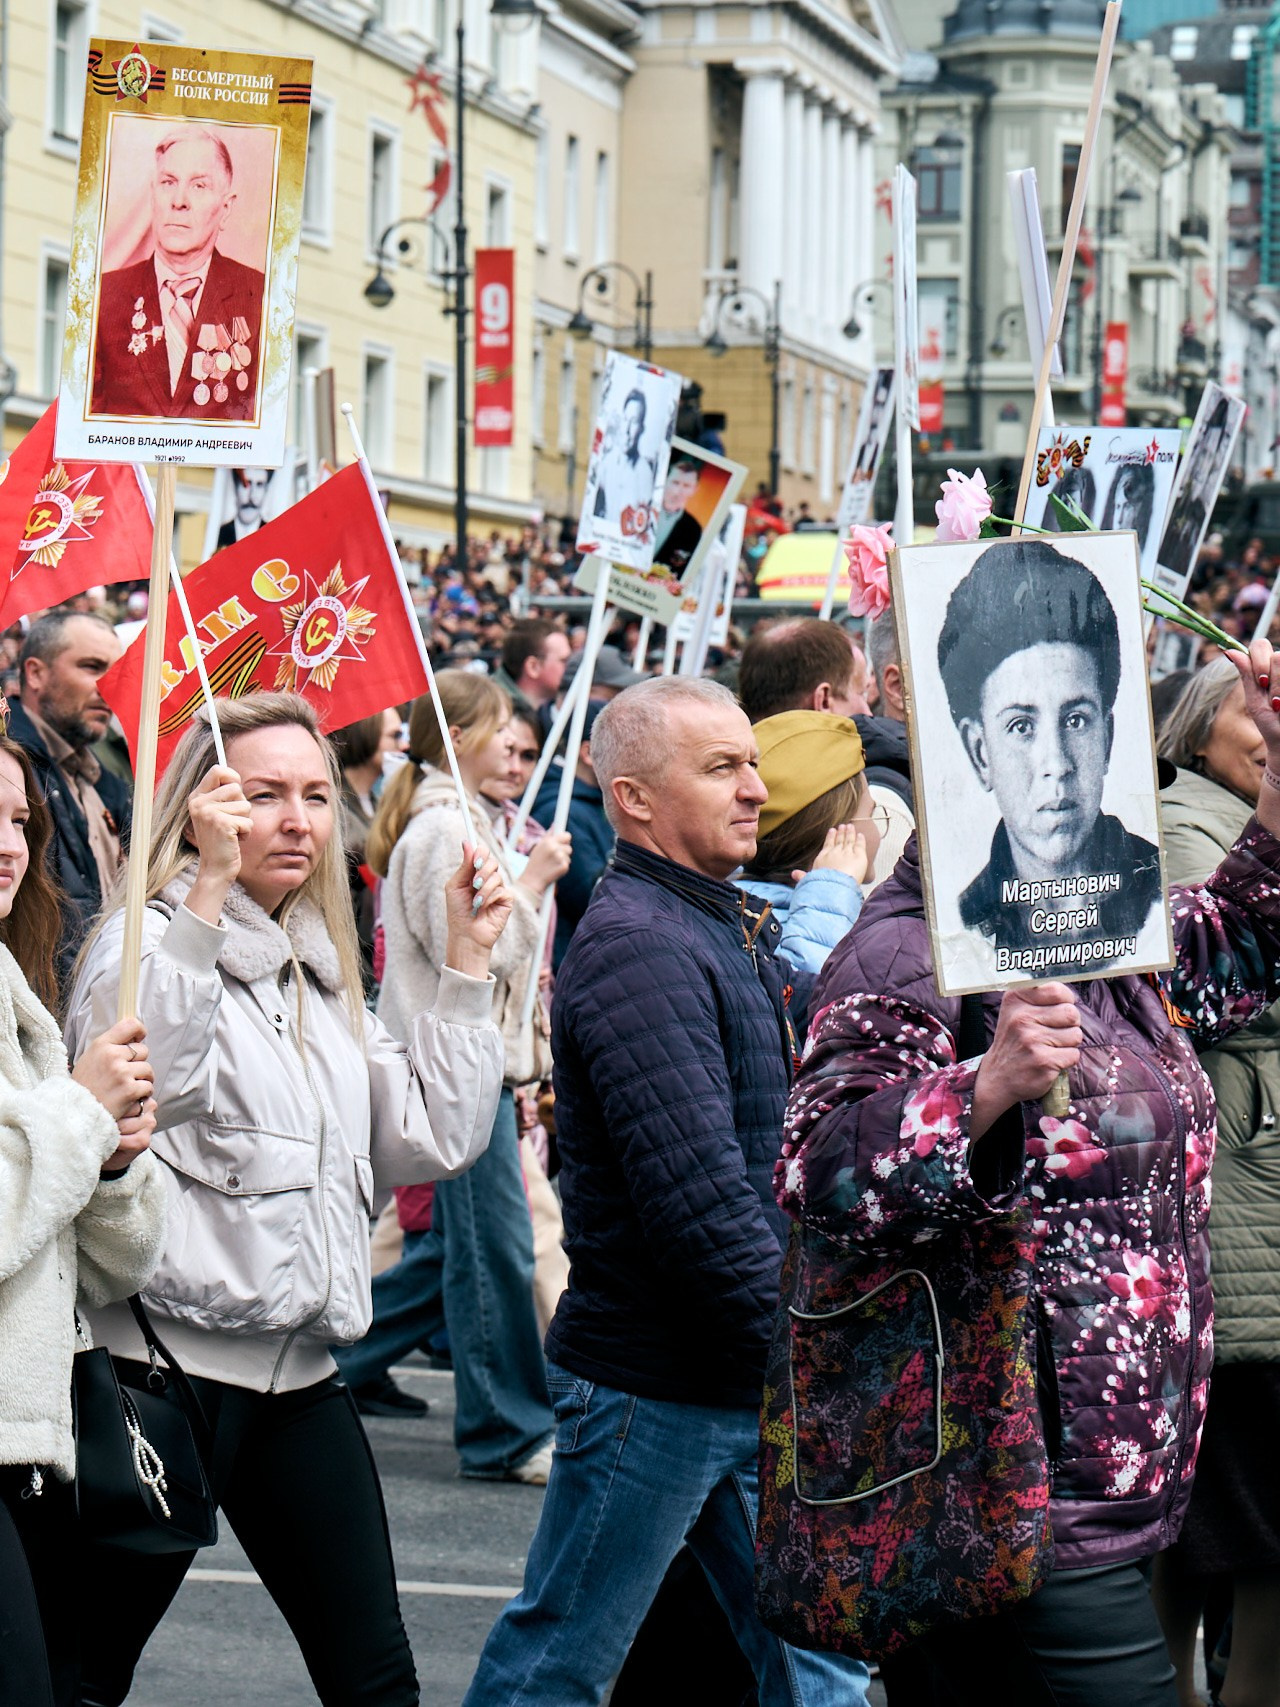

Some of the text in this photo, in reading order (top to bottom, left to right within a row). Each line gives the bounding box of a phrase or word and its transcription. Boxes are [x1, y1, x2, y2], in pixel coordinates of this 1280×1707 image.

[171, 67, 274, 90] БЕССМЕРТНЫЙ
[174, 84, 269, 106] ПОЛК РОССИИ
[480, 282, 510, 331] 9
[88, 434, 253, 450] БАРАНОВ ВЛАДИМИР АНДРЕЕВИЧ
[1002, 872, 1121, 906] Мартынович
[1031, 903, 1099, 935] Сергей
[996, 936, 1137, 972] Владимирович
